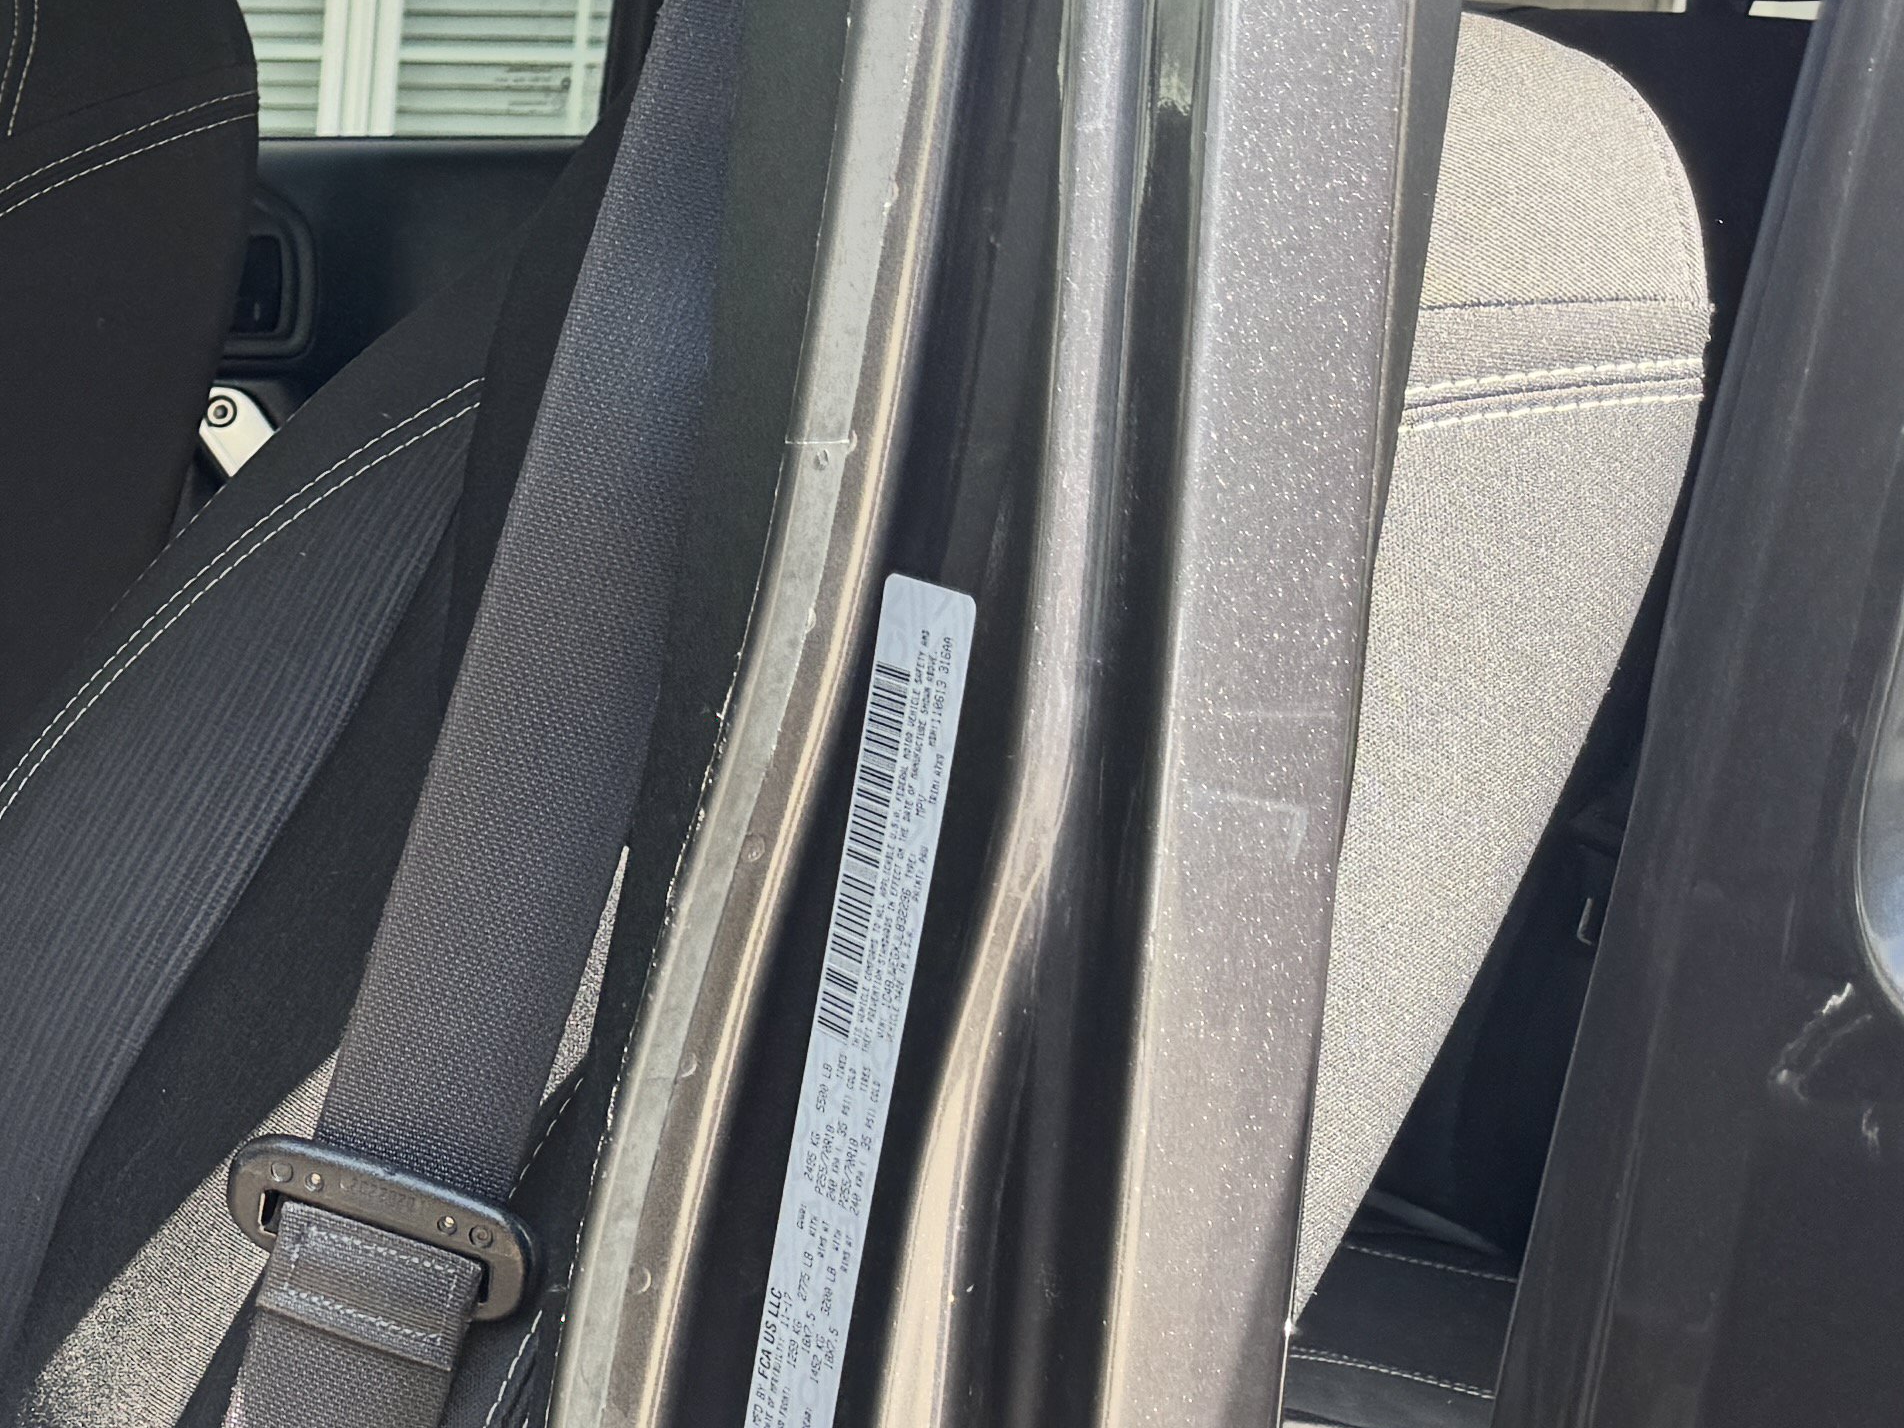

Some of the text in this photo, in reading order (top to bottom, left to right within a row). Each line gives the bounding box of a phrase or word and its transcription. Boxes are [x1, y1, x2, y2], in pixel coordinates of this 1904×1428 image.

[913, 791, 929, 820] MPV
[821, 1060, 833, 1080] LB
[815, 1080, 829, 1114] 5500
[808, 1128, 821, 1149] KG
[860, 1132, 872, 1151] 35
[825, 1177, 838, 1203] 240
[836, 1118, 848, 1139] 35
[802, 1248, 814, 1270] LB
[796, 1268, 811, 1304] 2775
[766, 1283, 782, 1320] LLC
[778, 1290, 793, 1330] 11-17
[814, 1330, 826, 1352] KG
[825, 1263, 837, 1284] LB
[763, 1317, 777, 1346] US
[791, 1316, 802, 1338] KG
[757, 1344, 772, 1381] FCA
[756, 1381, 766, 1401] BY
